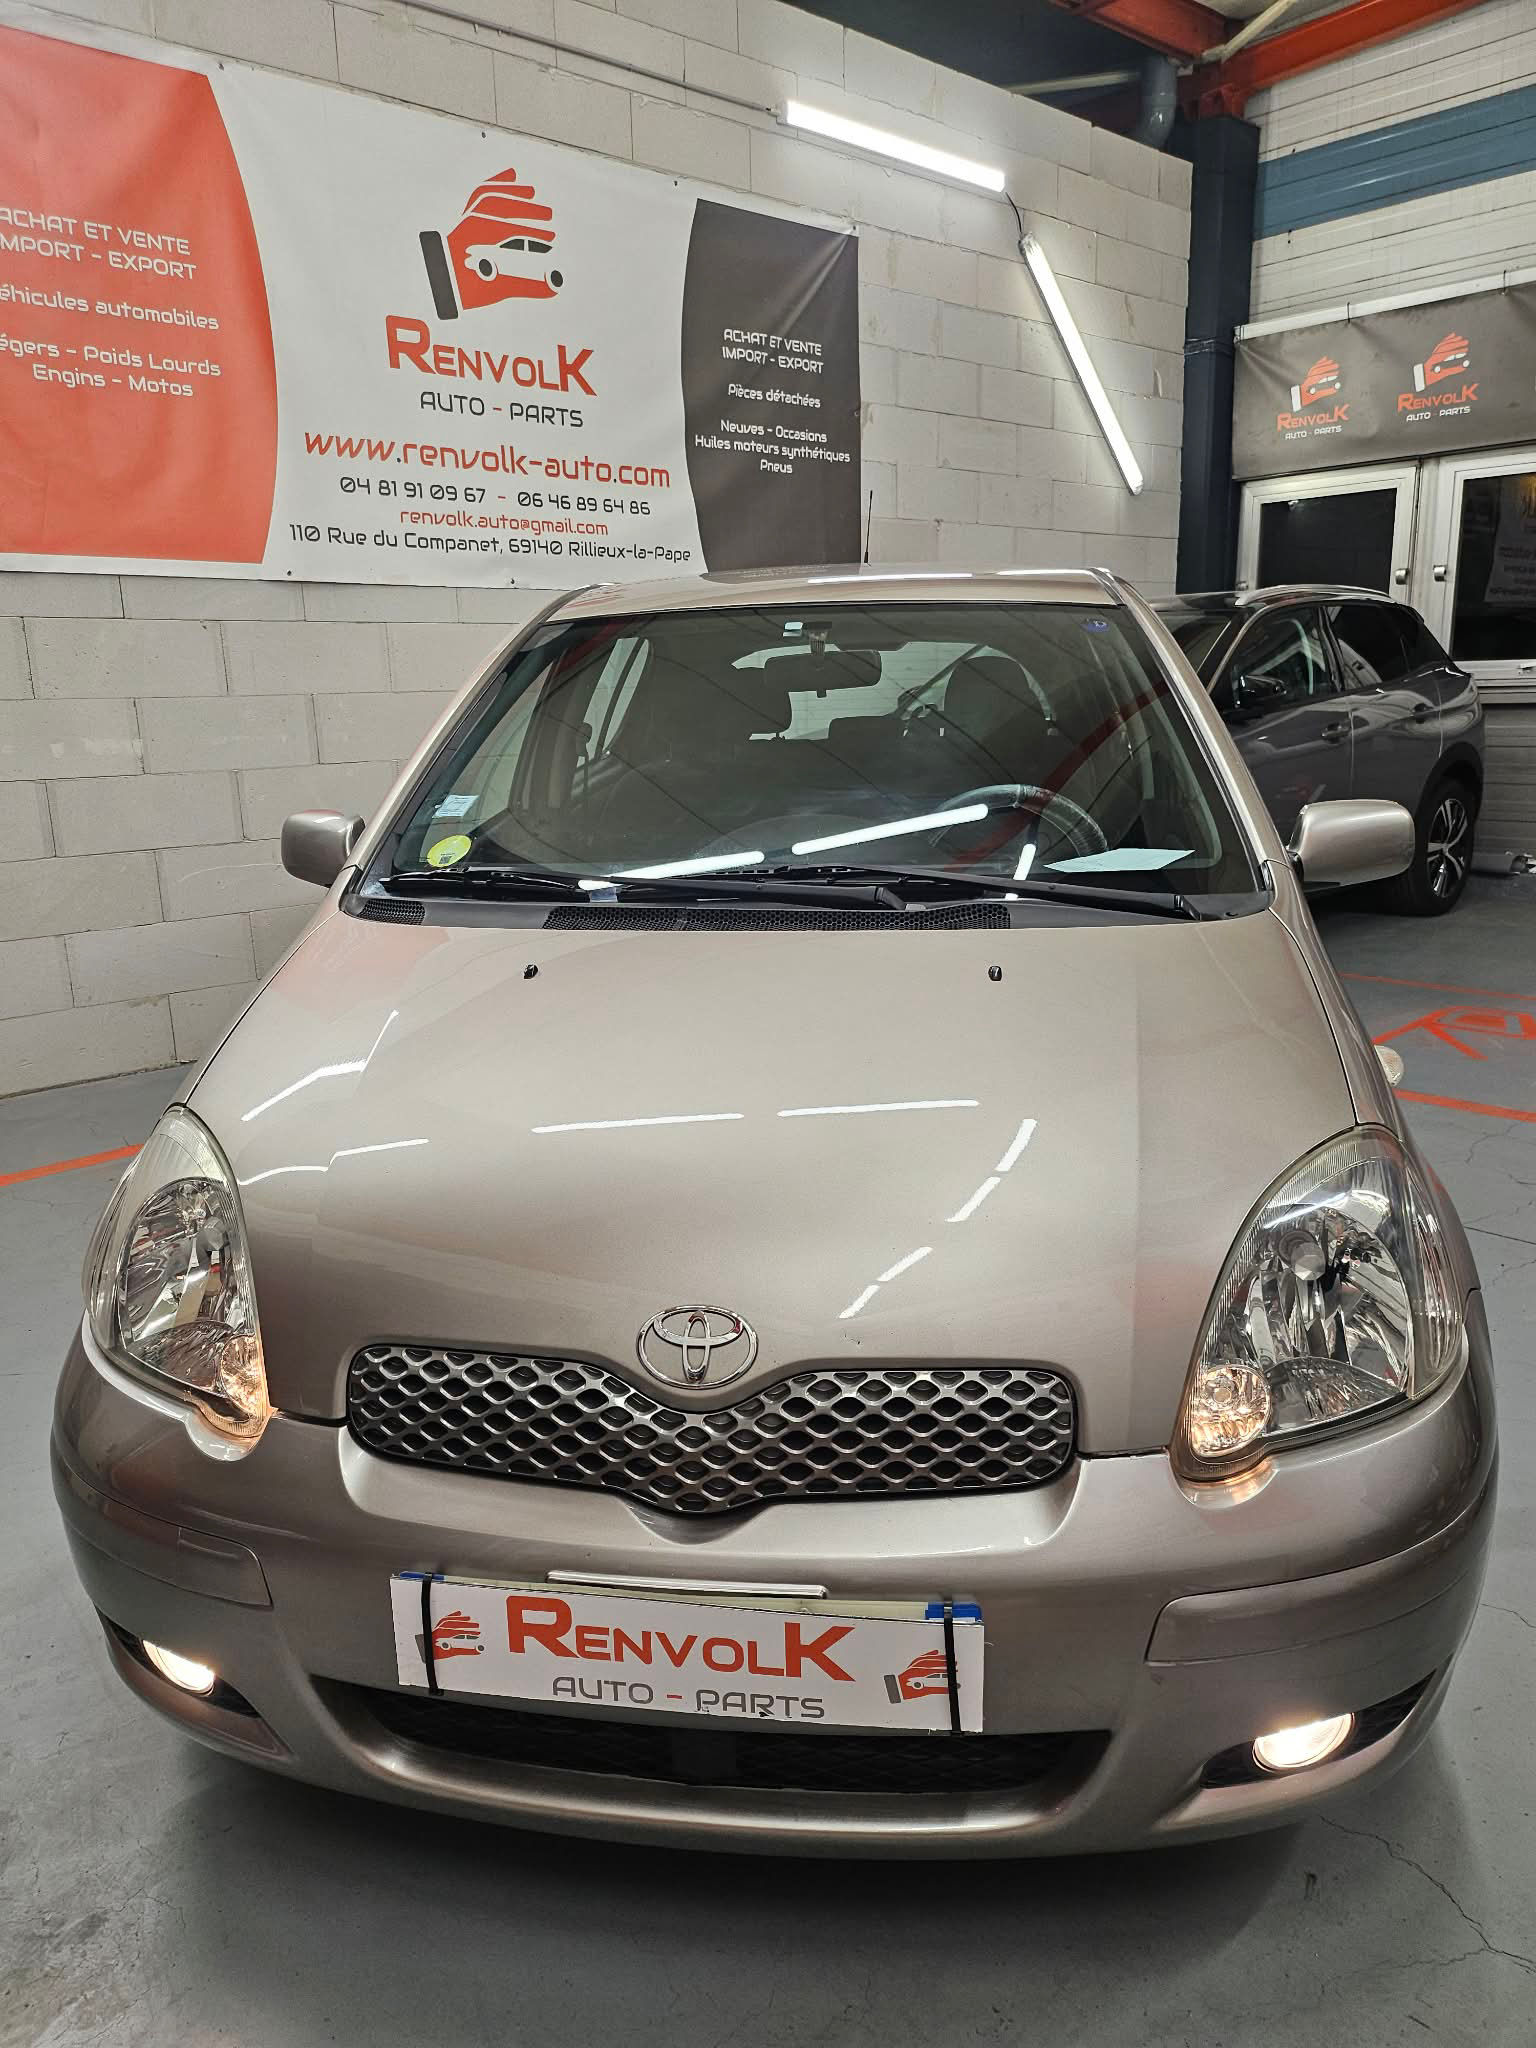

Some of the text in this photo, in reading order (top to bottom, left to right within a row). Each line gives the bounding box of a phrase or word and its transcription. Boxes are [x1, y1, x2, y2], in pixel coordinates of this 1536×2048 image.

[0, 207, 191, 256] ACHAT ET VENTE
[0, 233, 85, 262] MPORT
[108, 250, 197, 280] EXPORT
[0, 283, 220, 330] éhicules automobiles
[0, 333, 60, 358] égers
[83, 345, 143, 368] Poids
[148, 353, 222, 377] Lourds
[385, 314, 597, 396] RENVOLK
[723, 328, 822, 356] ACHAT ET VENTE
[722, 346, 769, 365] IMPORT
[778, 355, 825, 374] EXPORT
[32, 363, 106, 389] Engins
[128, 374, 194, 397] Motos
[727, 383, 821, 409] Pièces détachées
[420, 391, 485, 416] AUTO
[509, 402, 584, 428] PARTS
[1397, 383, 1480, 413] RENVOLK
[1405, 411, 1432, 423] AUTO
[1439, 405, 1472, 418] PARTS
[720, 419, 765, 436] Neuves
[775, 425, 828, 443] Occasions
[1276, 403, 1350, 432] RENVOLK
[1284, 430, 1307, 441] AUTO
[1313, 424, 1343, 436] PARTS
[304, 432, 670, 488] www.renvolk-auto.com
[695, 434, 851, 463] Huiles moteurs synthétiques
[760, 458, 793, 474] Pneus
[340, 476, 371, 495] 04
[378, 479, 398, 497] 81
[403, 481, 423, 499] 91
[429, 484, 458, 501] 09
[463, 487, 486, 504] 67
[517, 491, 544, 508] 06
[548, 493, 571, 510] 46
[576, 496, 598, 512] 89
[603, 498, 625, 515] 64
[629, 501, 651, 516] 86
[400, 511, 609, 536] renvolk.auto@gmail.com
[289, 523, 691, 563] 110 Rue du Companet, 69140 Rillieux-la-Pape
[505, 1595, 856, 1683] RENVOLK
[551, 1676, 654, 1705] AUTO
[695, 1688, 825, 1719] PARTS
